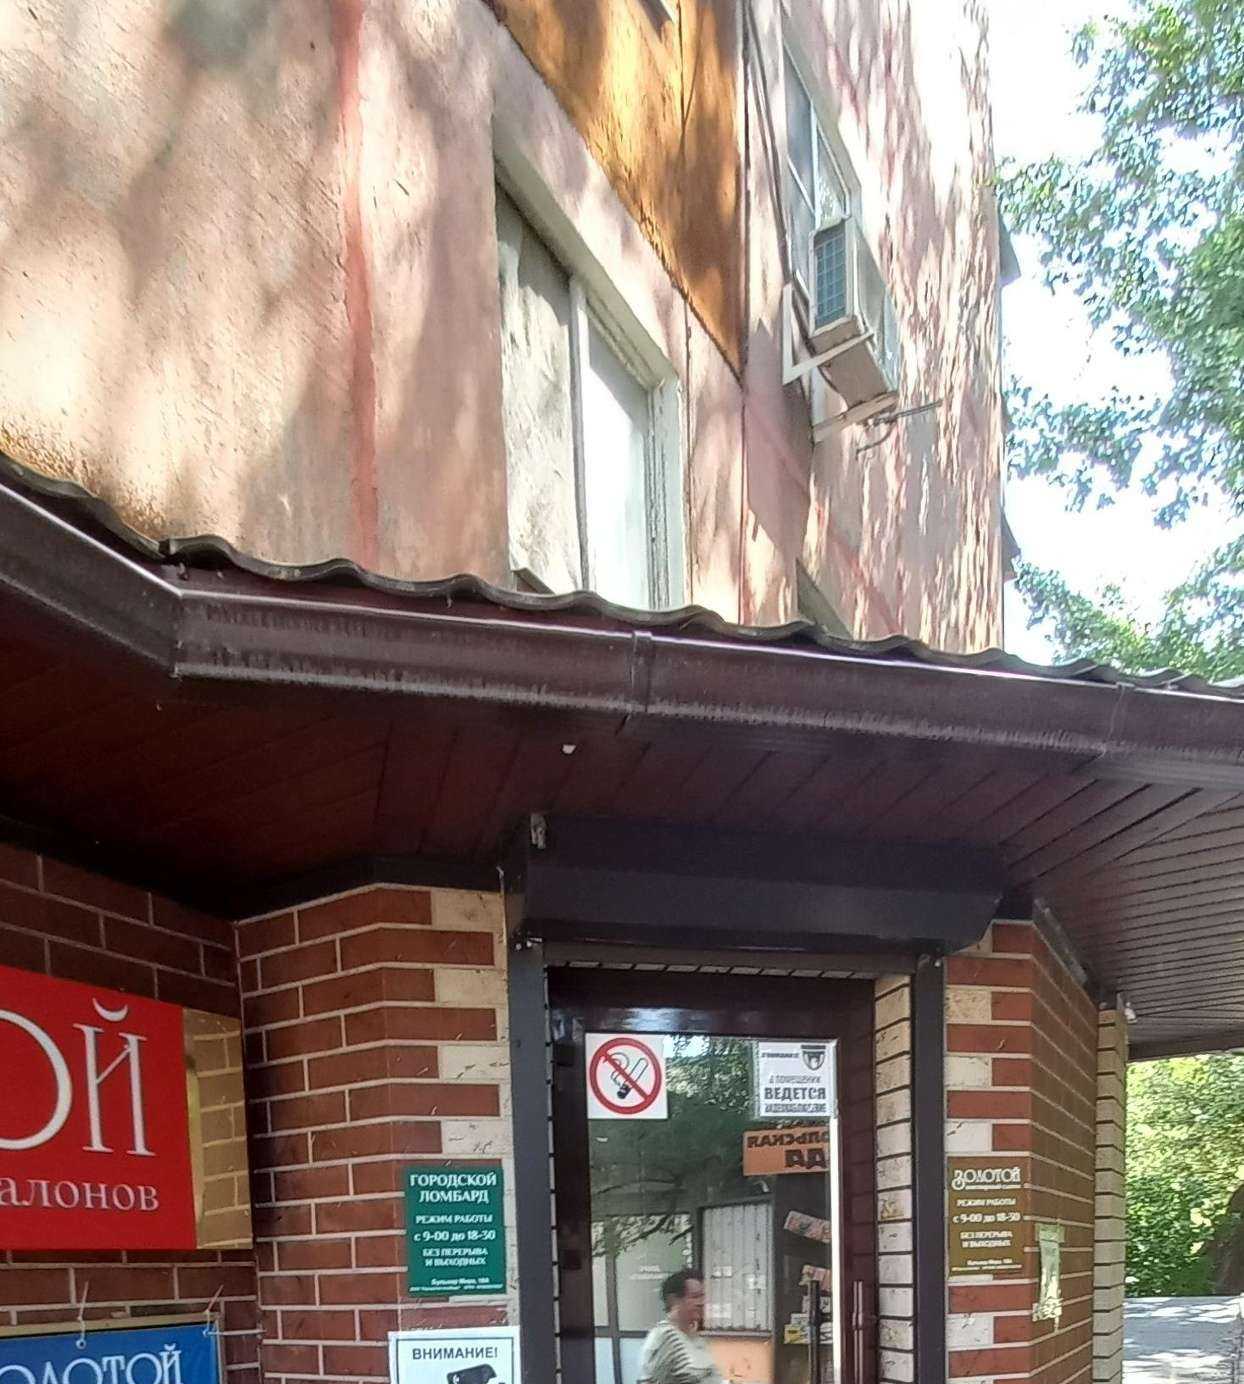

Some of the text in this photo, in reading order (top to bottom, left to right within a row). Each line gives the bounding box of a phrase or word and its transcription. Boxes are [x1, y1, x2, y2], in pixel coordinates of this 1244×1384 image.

[764, 1087, 826, 1101] ВЕДЕТСЯ
[410, 1172, 497, 1188] ГОРОДСКОЙ
[952, 1167, 1021, 1190] ЗОЛОТОЙ
[419, 1190, 489, 1204] ЛОМБАРД
[415, 1214, 493, 1224] РЕЖИМ РАБОТЫ
[414, 1229, 497, 1242] с 9-00 до 18-30
[412, 1347, 498, 1360] ВНИМАНИЕ!
